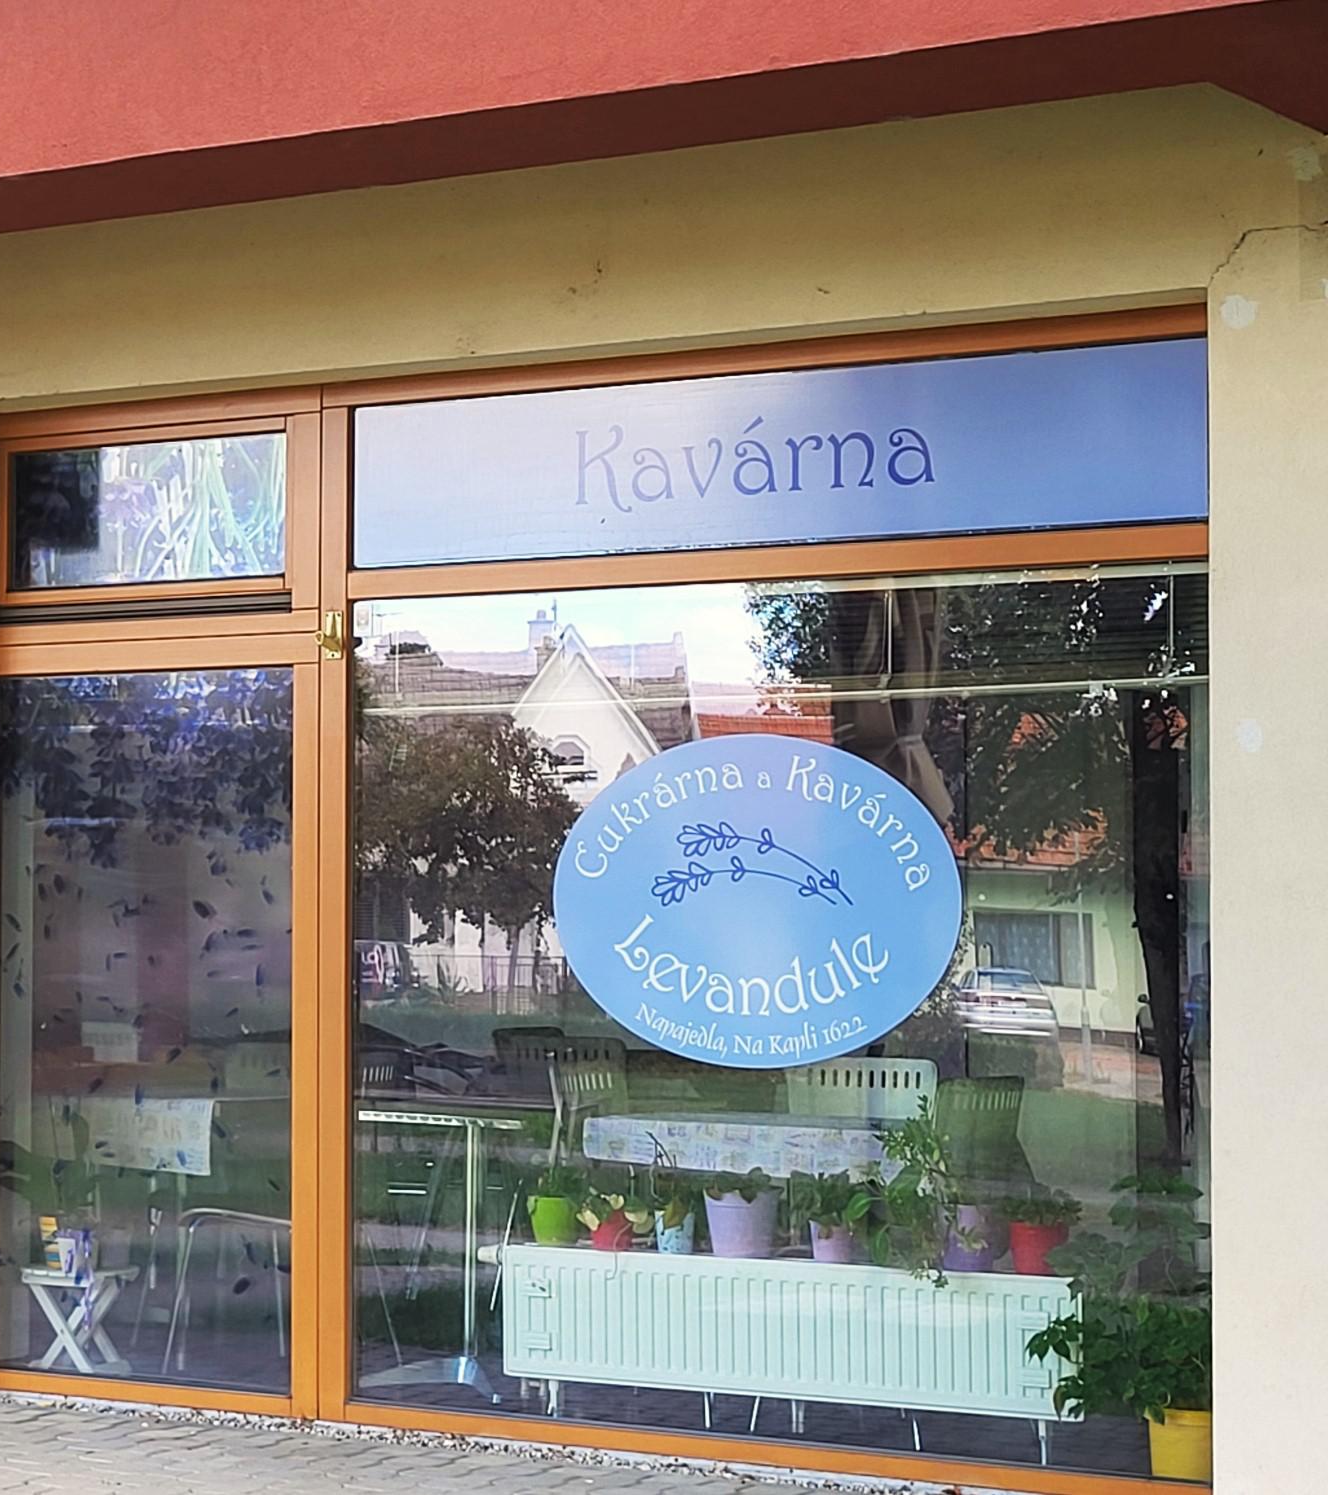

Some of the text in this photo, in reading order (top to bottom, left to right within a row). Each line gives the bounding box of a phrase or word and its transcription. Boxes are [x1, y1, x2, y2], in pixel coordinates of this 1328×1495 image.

[575, 415, 935, 513] Kavárna
[574, 754, 931, 892] Cukrárna a Kavárna
[613, 914, 890, 1017] Levandule
[634, 1002, 868, 1059] Napajedla, Na Kapli 1622
